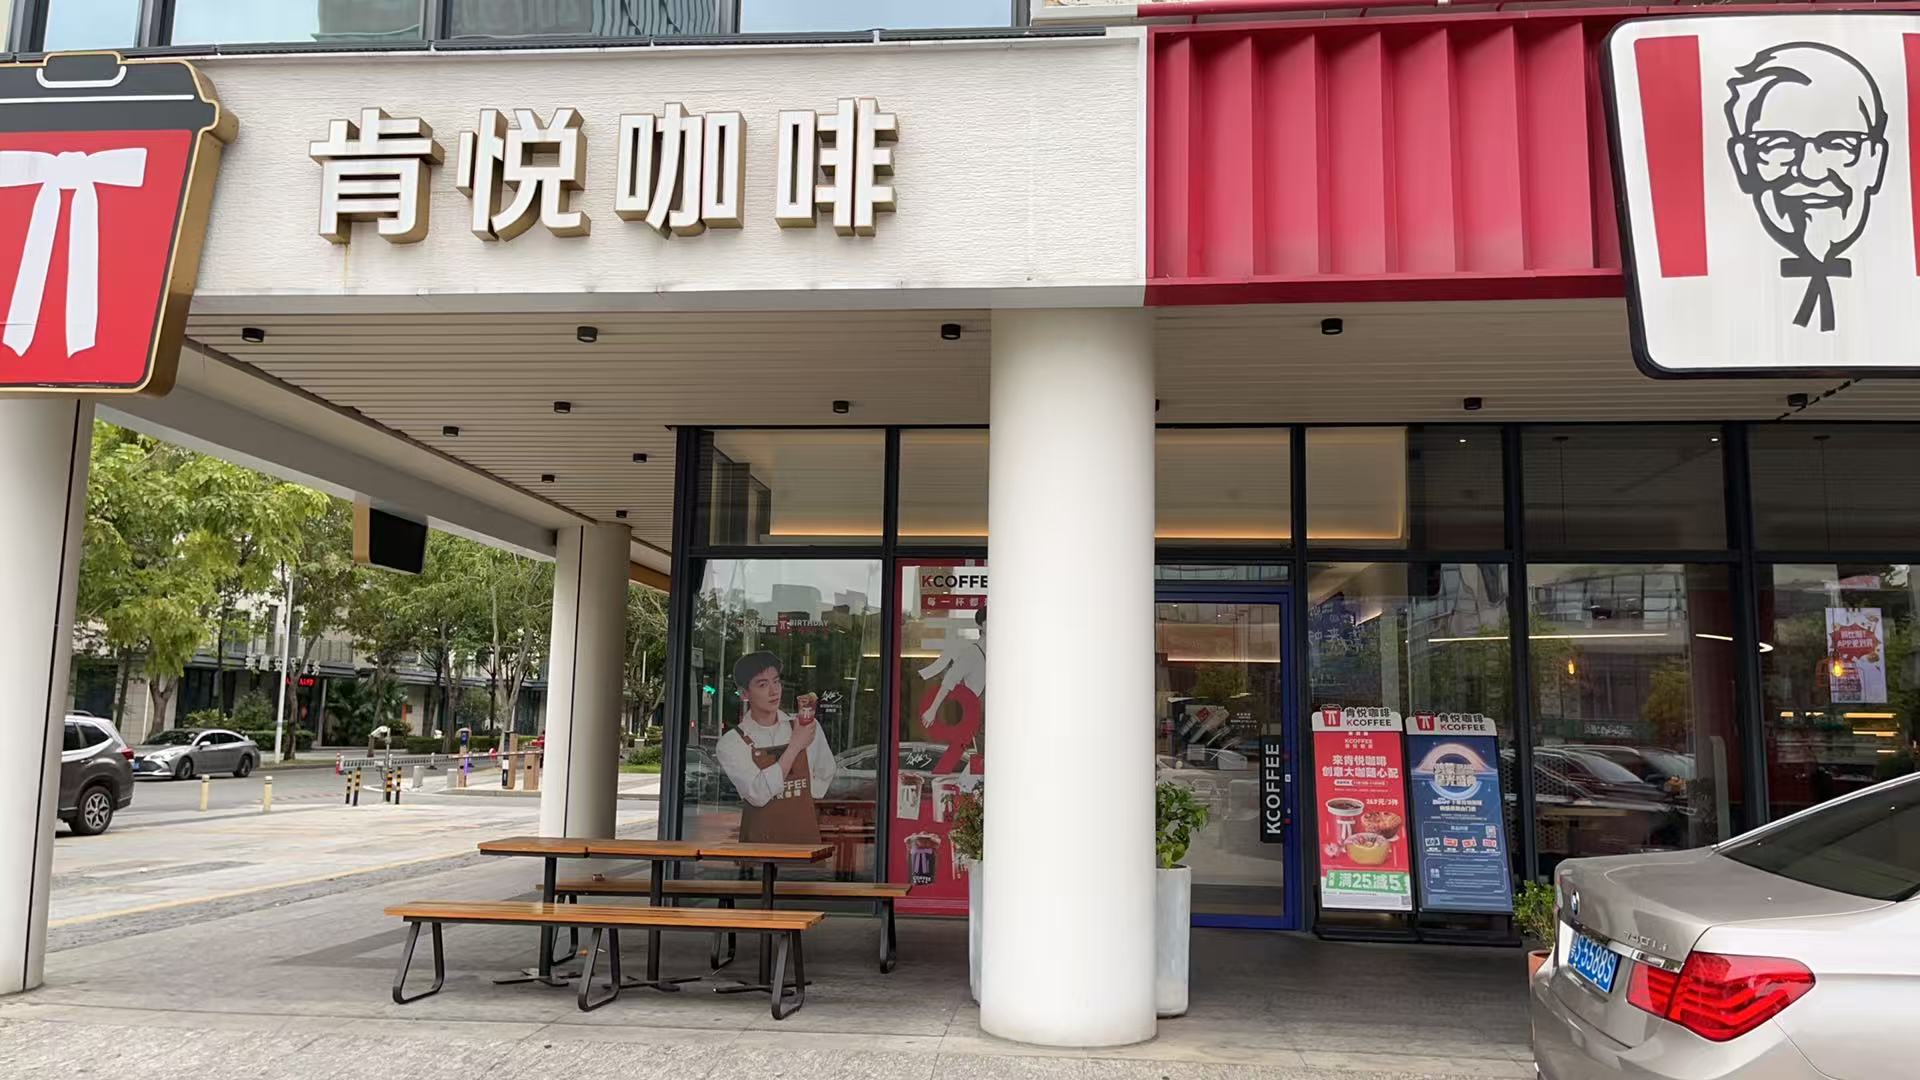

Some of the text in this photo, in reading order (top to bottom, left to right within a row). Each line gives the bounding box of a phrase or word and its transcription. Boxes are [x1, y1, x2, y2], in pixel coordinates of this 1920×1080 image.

[309, 97, 898, 244] 肯悦咖啡
[1345, 708, 1391, 718] 肯悦咖啡
[1346, 719, 1392, 727] KCOFFEE
[1440, 714, 1484, 723] 肯悦咖啡
[1440, 723, 1487, 731] KCOFFEE
[1265, 744, 1281, 834] KCOFFEE
[1339, 872, 1404, 891] 满25减5
